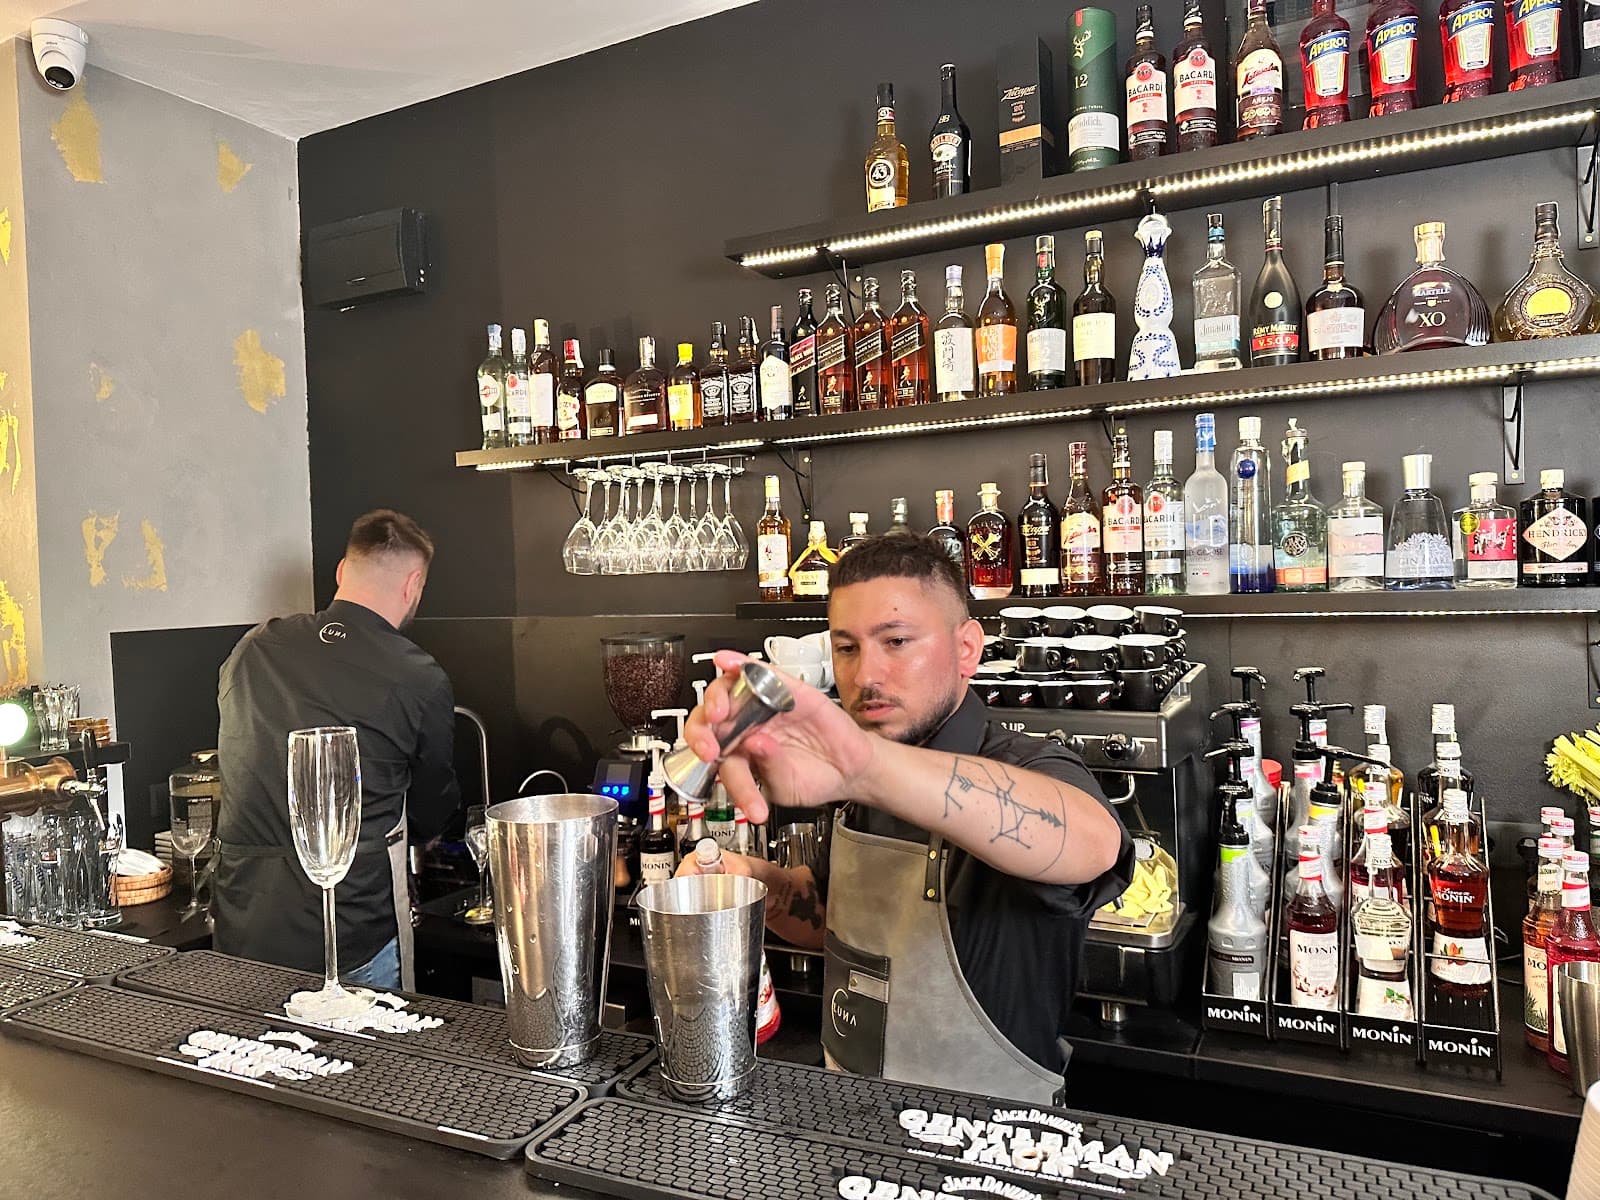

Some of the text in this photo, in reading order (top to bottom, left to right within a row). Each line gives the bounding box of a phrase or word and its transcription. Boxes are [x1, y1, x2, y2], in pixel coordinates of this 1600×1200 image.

[1452, 7, 1494, 33] APEROL
[1375, 22, 1416, 48] APEROL
[1309, 37, 1348, 61] APEROL
[1074, 73, 1089, 89] 12
[1419, 311, 1447, 328] XO
[1207, 1004, 1261, 1024] MONIN
[1278, 1015, 1335, 1035] MONIN
[1352, 1025, 1412, 1045] MONIN
[1428, 1037, 1491, 1058] MONIN
[992, 1108, 1028, 1123] JACK
[941, 1174, 982, 1193] JACK
